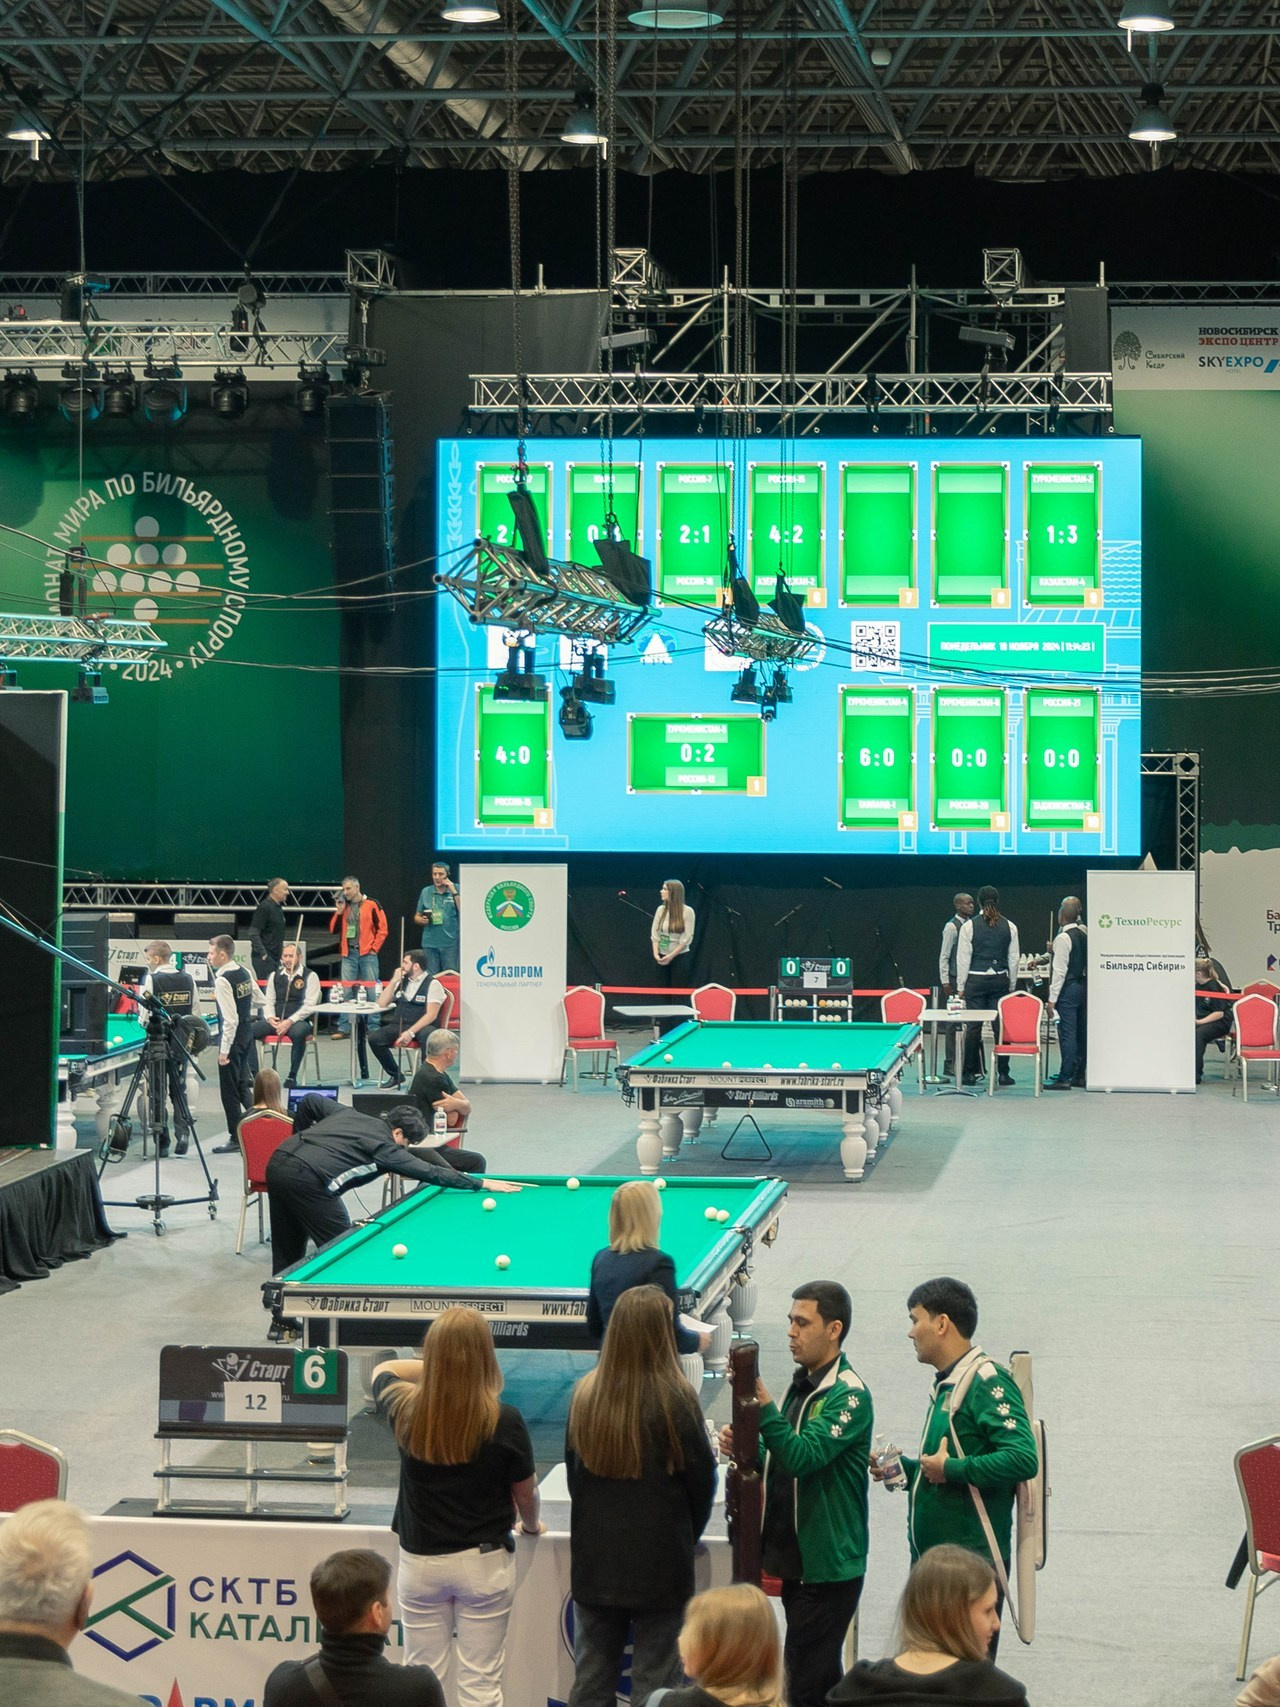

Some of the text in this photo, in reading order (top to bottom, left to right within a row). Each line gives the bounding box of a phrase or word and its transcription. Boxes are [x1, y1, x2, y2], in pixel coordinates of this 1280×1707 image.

[1198, 328, 1279, 336] НОВОСИБИРСК
[1198, 356, 1264, 368] SKYEXPO
[104, 473, 136, 500] ПО
[53, 489, 107, 545] МИРА
[142, 471, 250, 590] БИЛЬЯРДНОМУ
[680, 525, 710, 545] 2:1
[769, 525, 803, 545] 4:2
[1046, 524, 1078, 545] 1:3
[189, 593, 247, 669] СПОРТУ
[495, 745, 530, 765] 4:0
[680, 743, 715, 763] 0:2
[859, 748, 895, 767] 6:0
[951, 748, 987, 767] 0:0
[1044, 748, 1080, 768] 0:0
[1115, 916, 1183, 930] ТехноРесурс
[117, 949, 140, 961] Старт
[496, 965, 543, 979] ГАЗПРОМ
[786, 961, 796, 976] 0
[836, 961, 846, 976] 0
[1100, 960, 1186, 973] «Бильярд Сибири»
[710, 1076, 738, 1084] MOUNT
[735, 1090, 751, 1101] Start
[795, 1098, 825, 1106] aramith
[320, 1296, 393, 1315] Фабрика Старт
[415, 1300, 457, 1313] MOUNT
[249, 1360, 291, 1383] Старт
[303, 1355, 326, 1389] 6
[245, 1393, 268, 1411] 12
[189, 1575, 298, 1606] СКТБ
